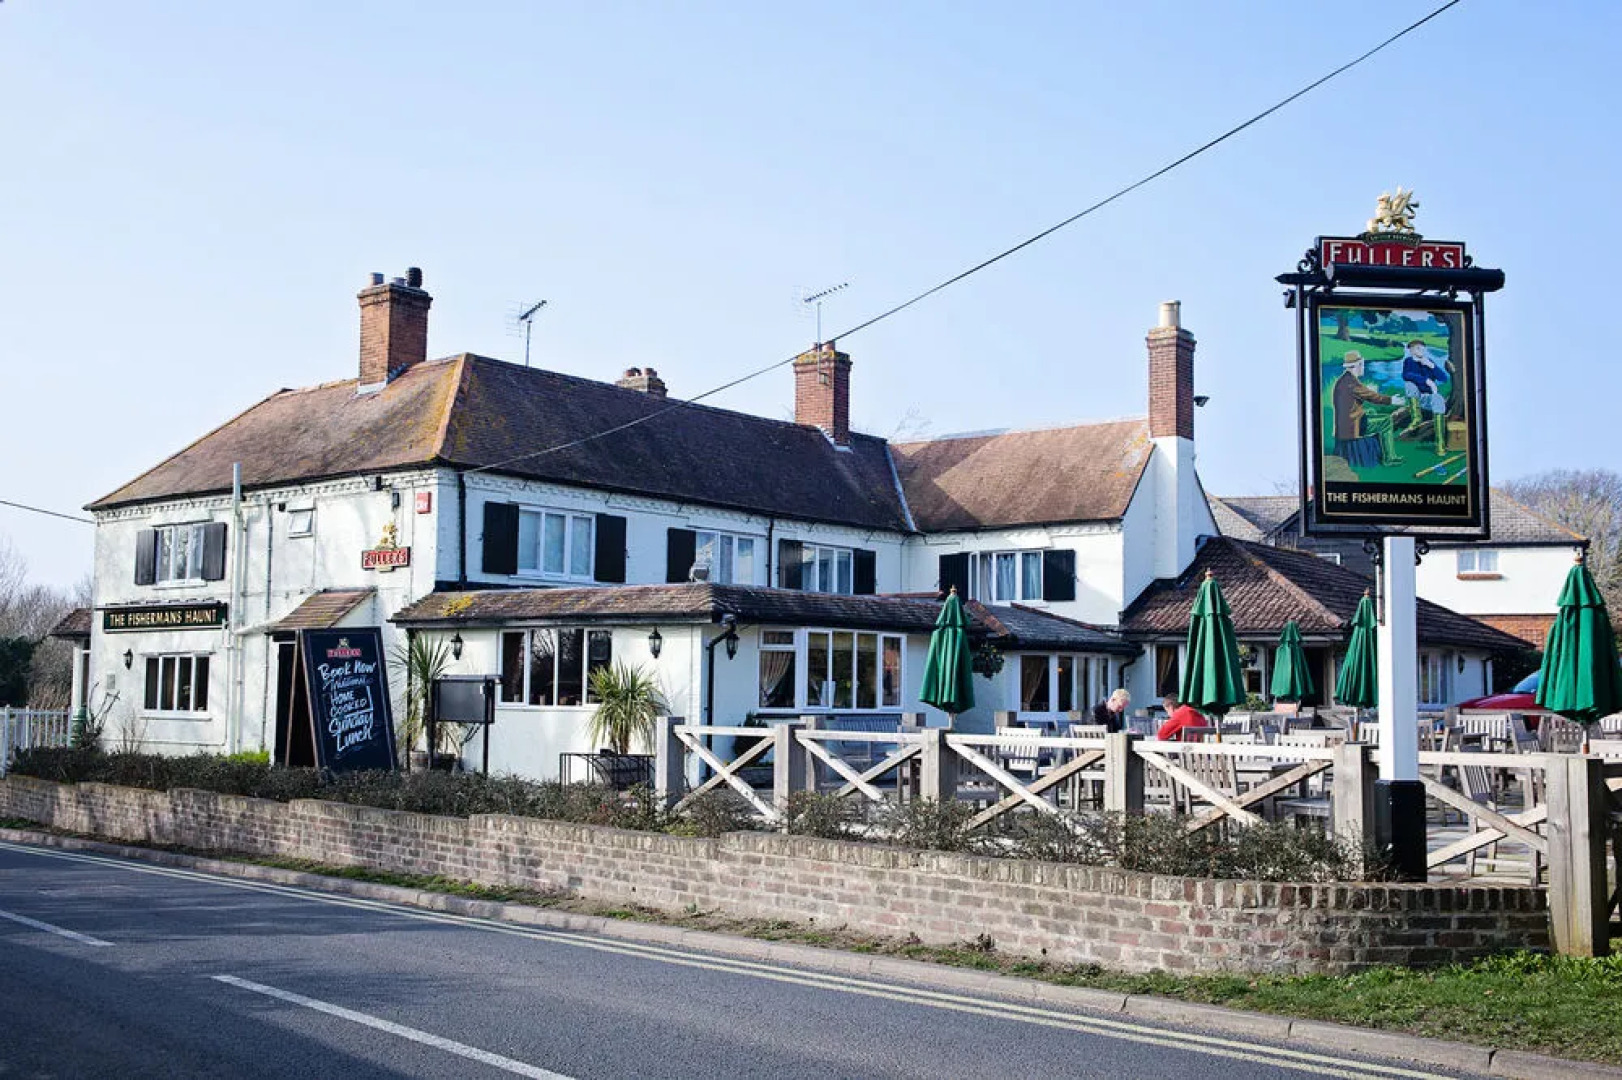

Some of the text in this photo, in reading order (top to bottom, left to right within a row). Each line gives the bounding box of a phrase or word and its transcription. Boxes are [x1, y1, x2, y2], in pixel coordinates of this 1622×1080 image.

[1329, 242, 1455, 268] FULLER'S
[1326, 492, 1467, 505] THE FISHERMANS HAUNT
[109, 609, 217, 627] THE FISHERMANS HAUNT
